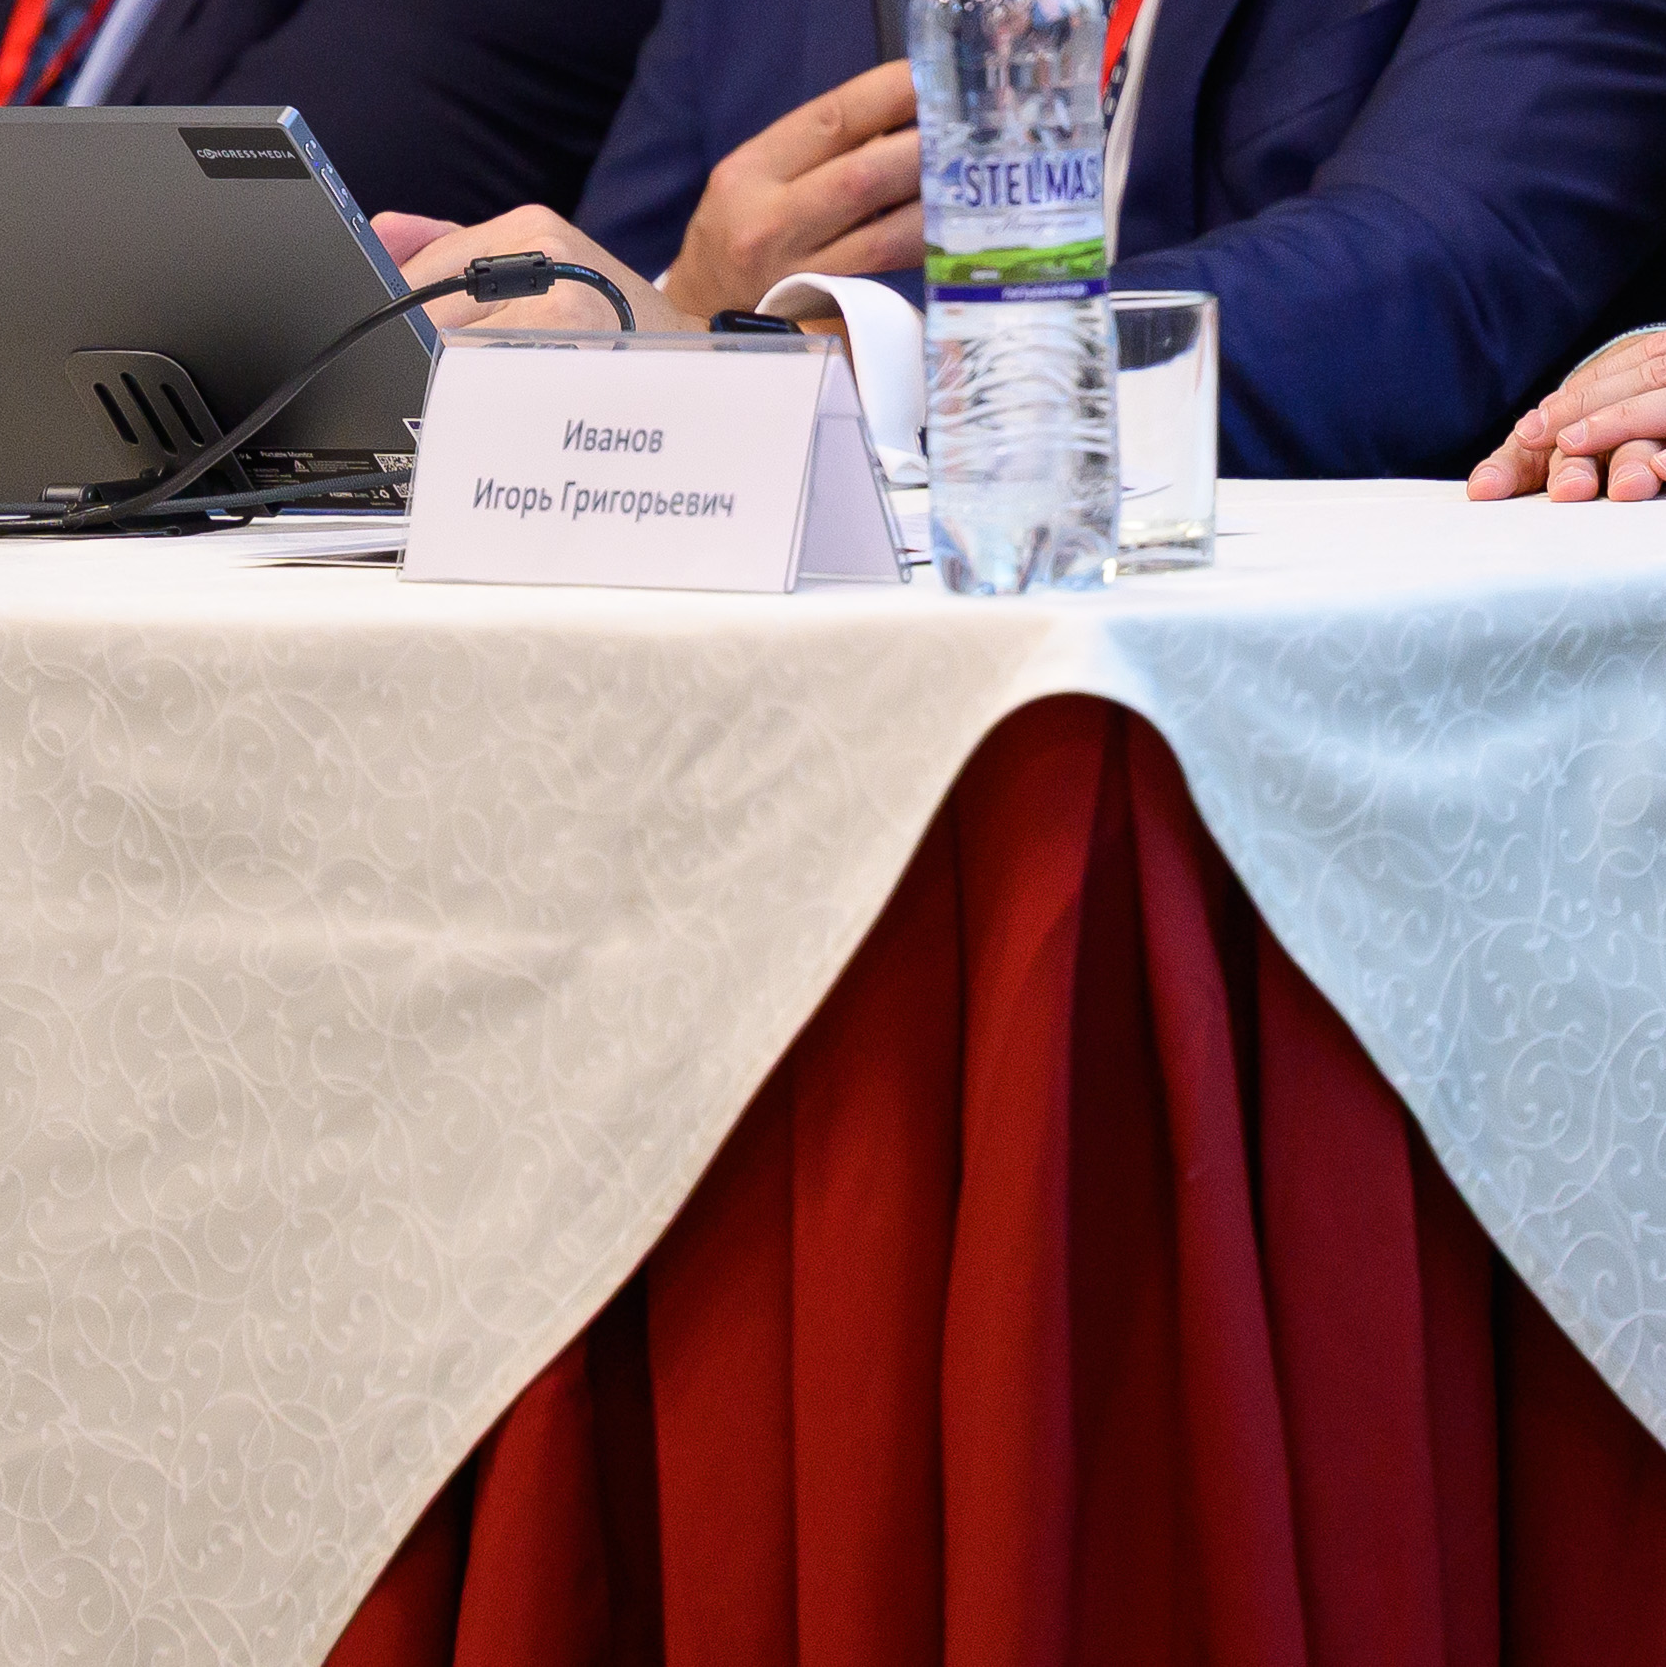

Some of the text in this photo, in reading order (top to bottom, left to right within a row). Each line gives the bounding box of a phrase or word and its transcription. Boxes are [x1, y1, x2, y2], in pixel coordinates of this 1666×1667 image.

[196, 148, 296, 160] CONGRESS MEDIA
[562, 420, 664, 454] Иванов
[473, 477, 735, 524] Игорь Григорьевич
